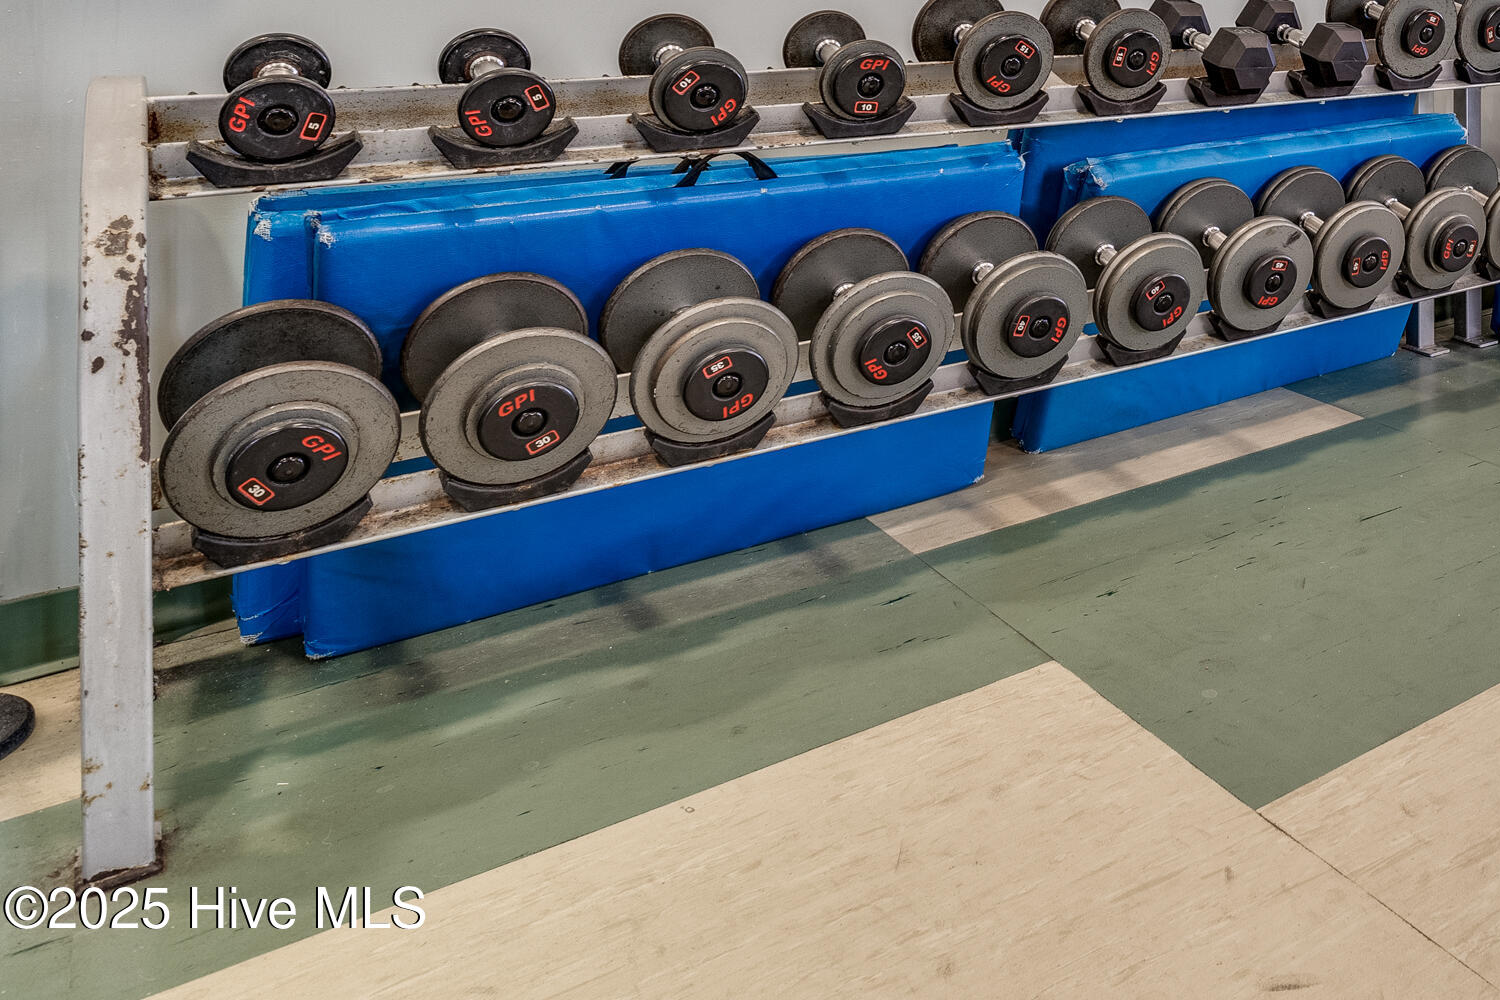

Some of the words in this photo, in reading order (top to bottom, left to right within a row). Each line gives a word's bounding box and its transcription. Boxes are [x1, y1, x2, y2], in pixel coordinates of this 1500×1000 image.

[860, 59, 891, 71] GPI
[1146, 51, 1160, 76] GPI
[679, 77, 692, 88] 10
[986, 75, 1011, 93] GPI
[532, 93, 543, 101] 5
[228, 97, 255, 133] GPI
[710, 98, 737, 126] GPI
[308, 122, 320, 130] 5
[465, 109, 493, 137] GPI
[1162, 306, 1183, 327] GPI
[912, 332, 922, 343] 35
[1050, 317, 1067, 343] GPI
[710, 361, 725, 373] 35
[864, 358, 888, 380] GPI
[498, 389, 535, 417] GPI
[723, 393, 754, 419] GPI
[302, 435, 343, 461] GPI
[535, 436, 551, 448] 30
[248, 484, 265, 498] 30
